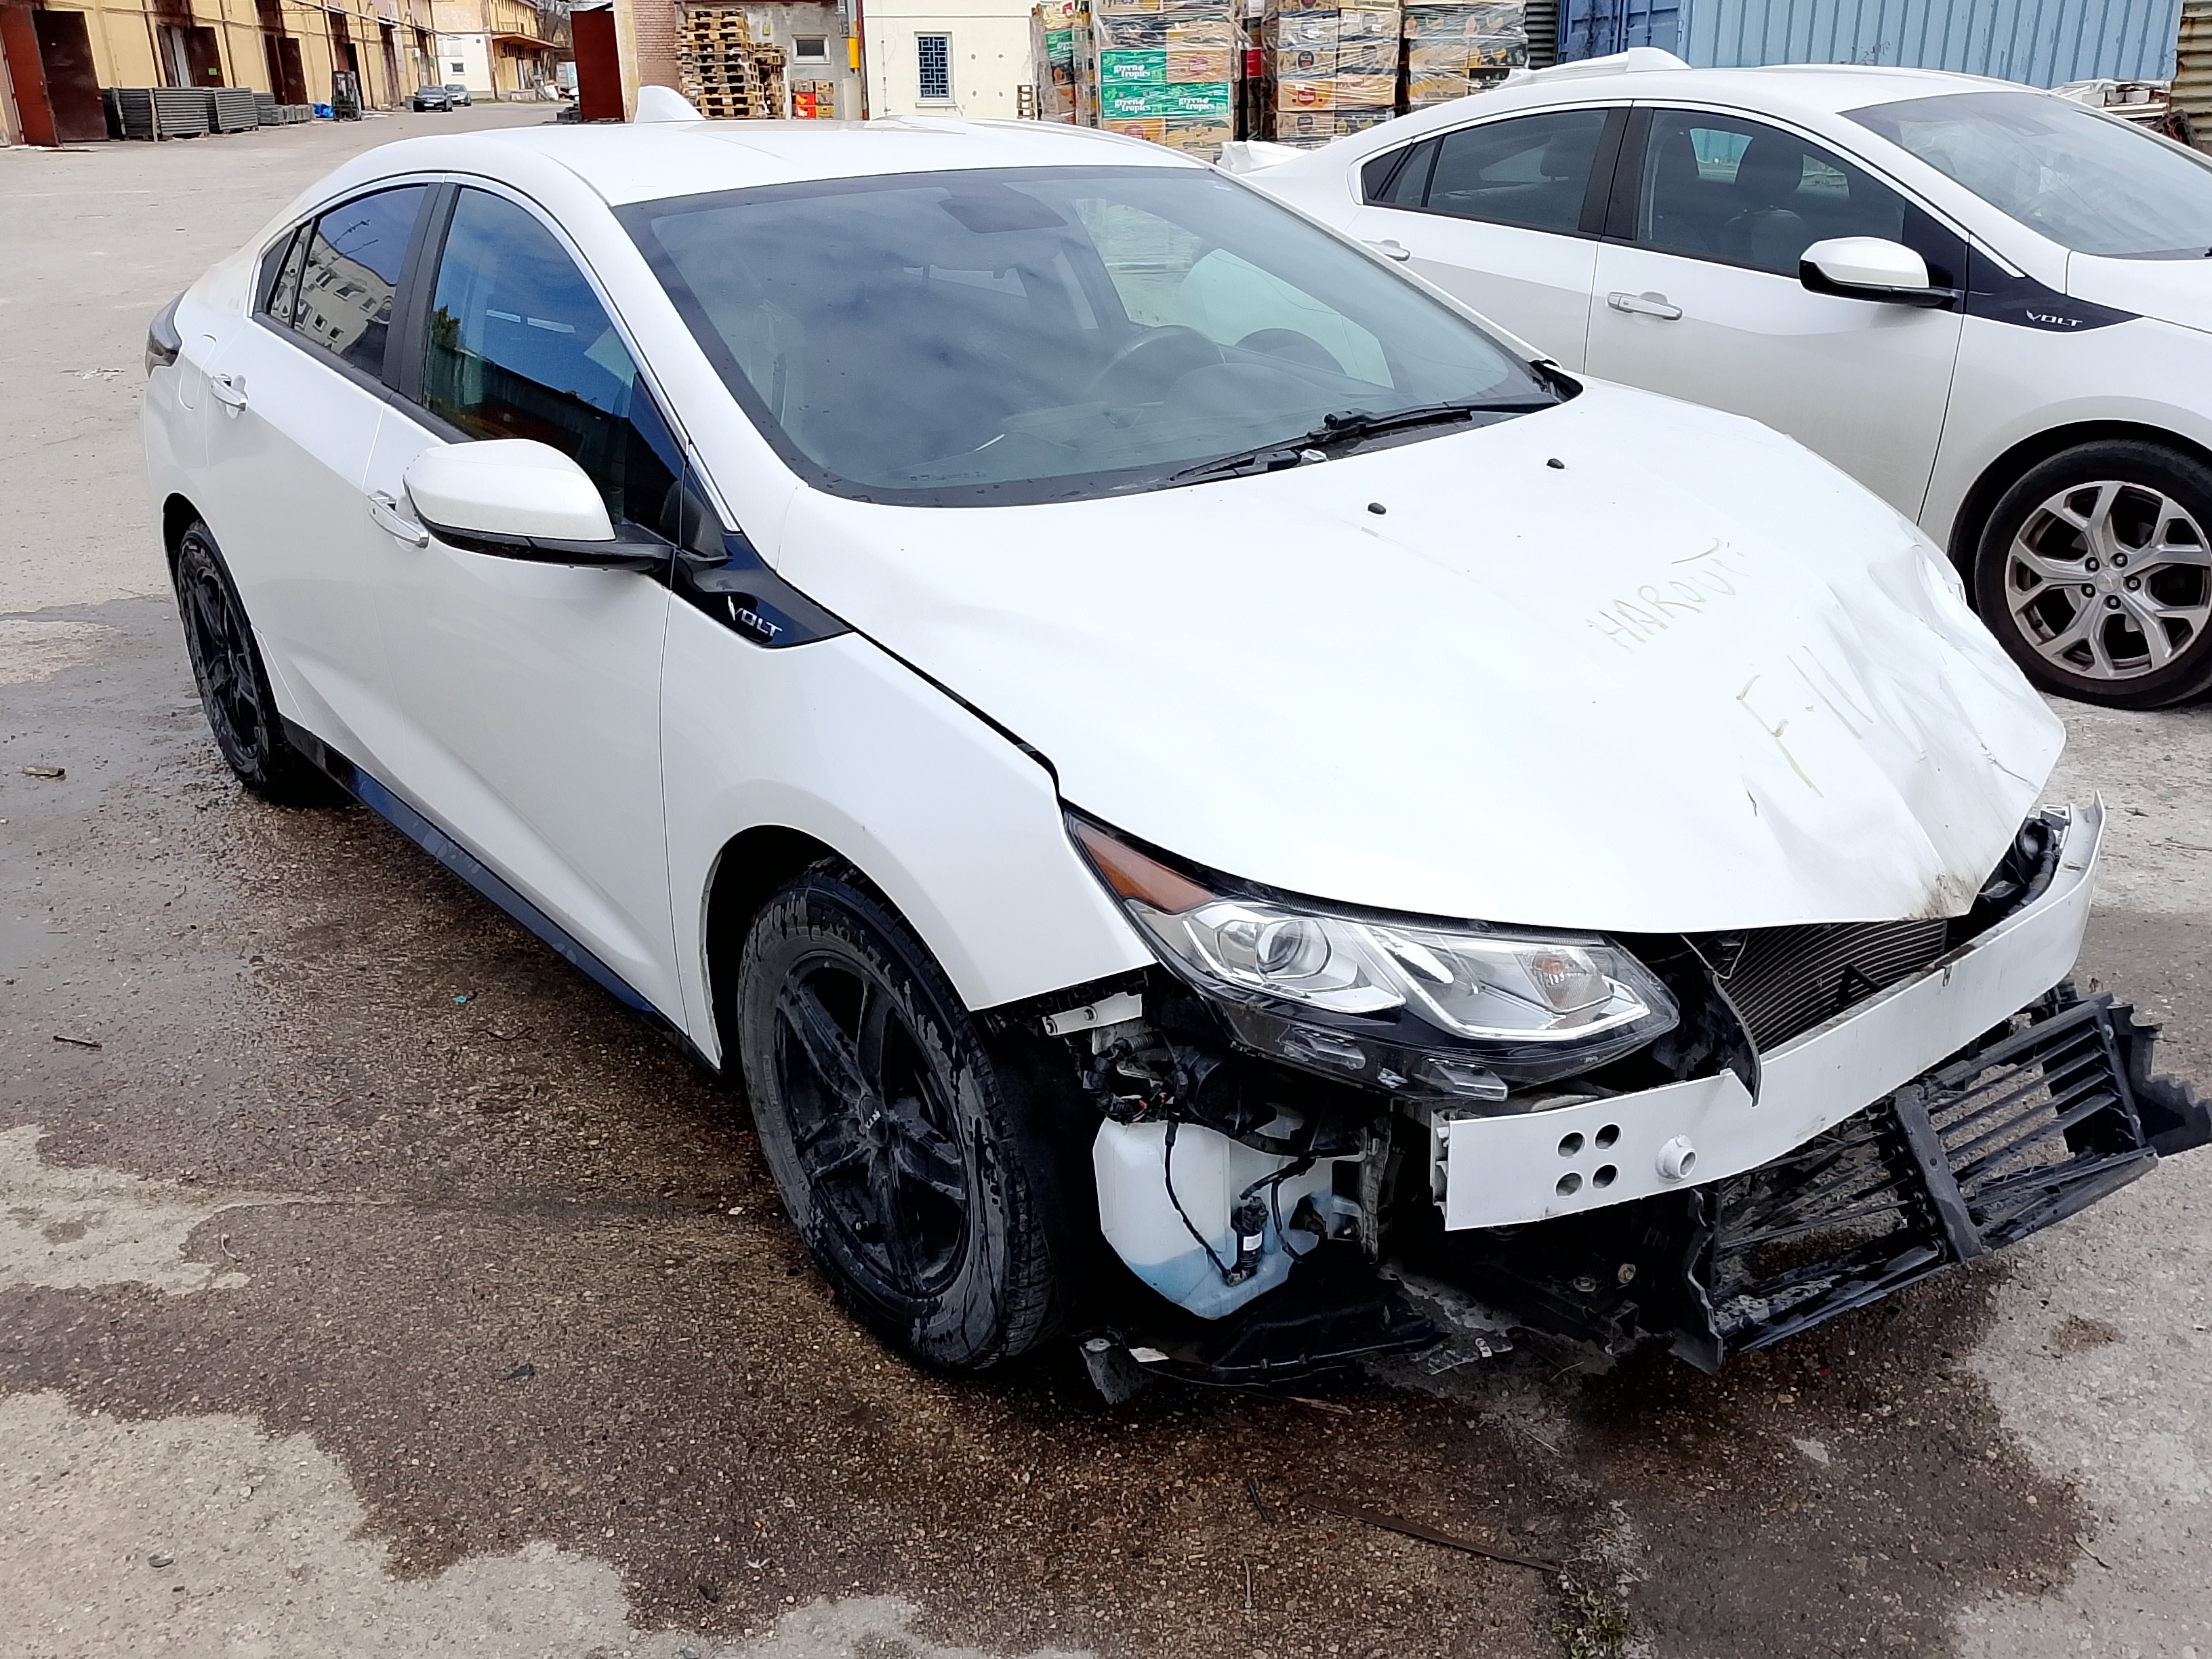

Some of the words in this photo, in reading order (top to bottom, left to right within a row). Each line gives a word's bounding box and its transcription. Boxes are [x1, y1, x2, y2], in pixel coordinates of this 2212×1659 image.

[1114, 64, 1138, 74] green
[1122, 70, 1151, 79] tropics
[1122, 105, 1151, 114] tropics
[1186, 103, 1215, 112] tropics
[2026, 310, 2083, 327] VOLT
[727, 595, 783, 637] VOLT
